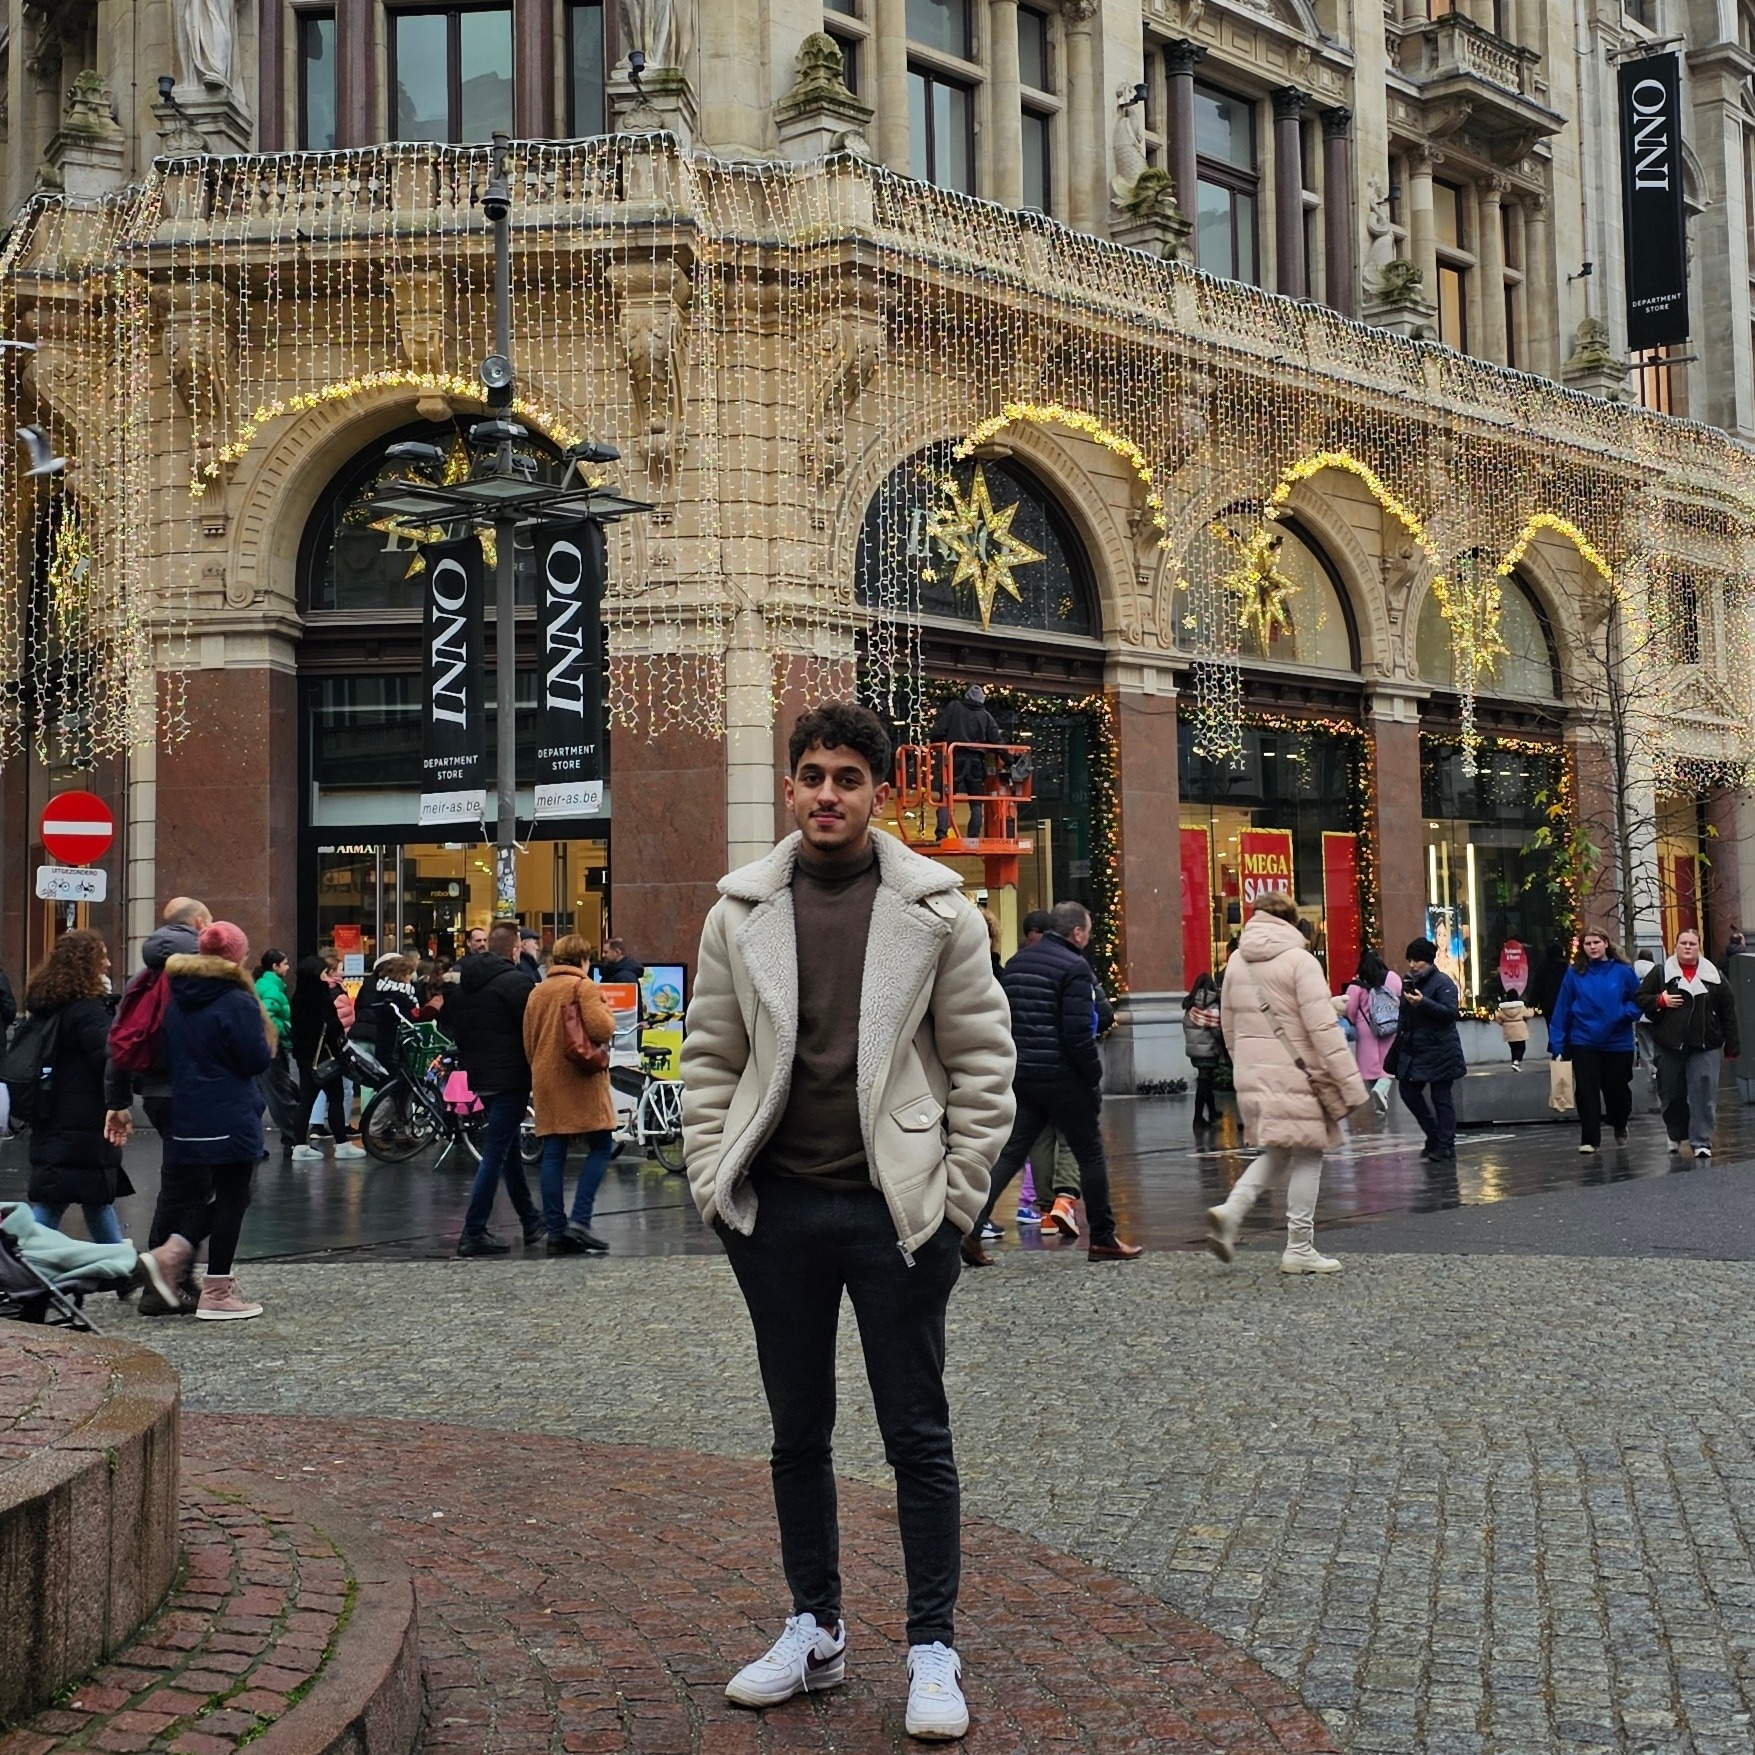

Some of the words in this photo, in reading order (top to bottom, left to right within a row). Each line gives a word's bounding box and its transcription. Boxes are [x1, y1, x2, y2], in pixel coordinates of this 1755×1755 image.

[1632, 79, 1669, 191] INNO
[1632, 292, 1682, 308] DEPARTMENT
[1645, 303, 1670, 314] STORE
[546, 540, 584, 718] INNO
[432, 558, 467, 730] INNO
[537, 744, 596, 759] DEPARTMENT
[423, 754, 479, 769] DEPARTMENT
[552, 759, 581, 771] STORE
[437, 769, 463, 781] STORE
[536, 790, 598, 806] meir-as.be
[422, 800, 481, 815] meir-as.be
[1244, 853, 1289, 875] MEGA
